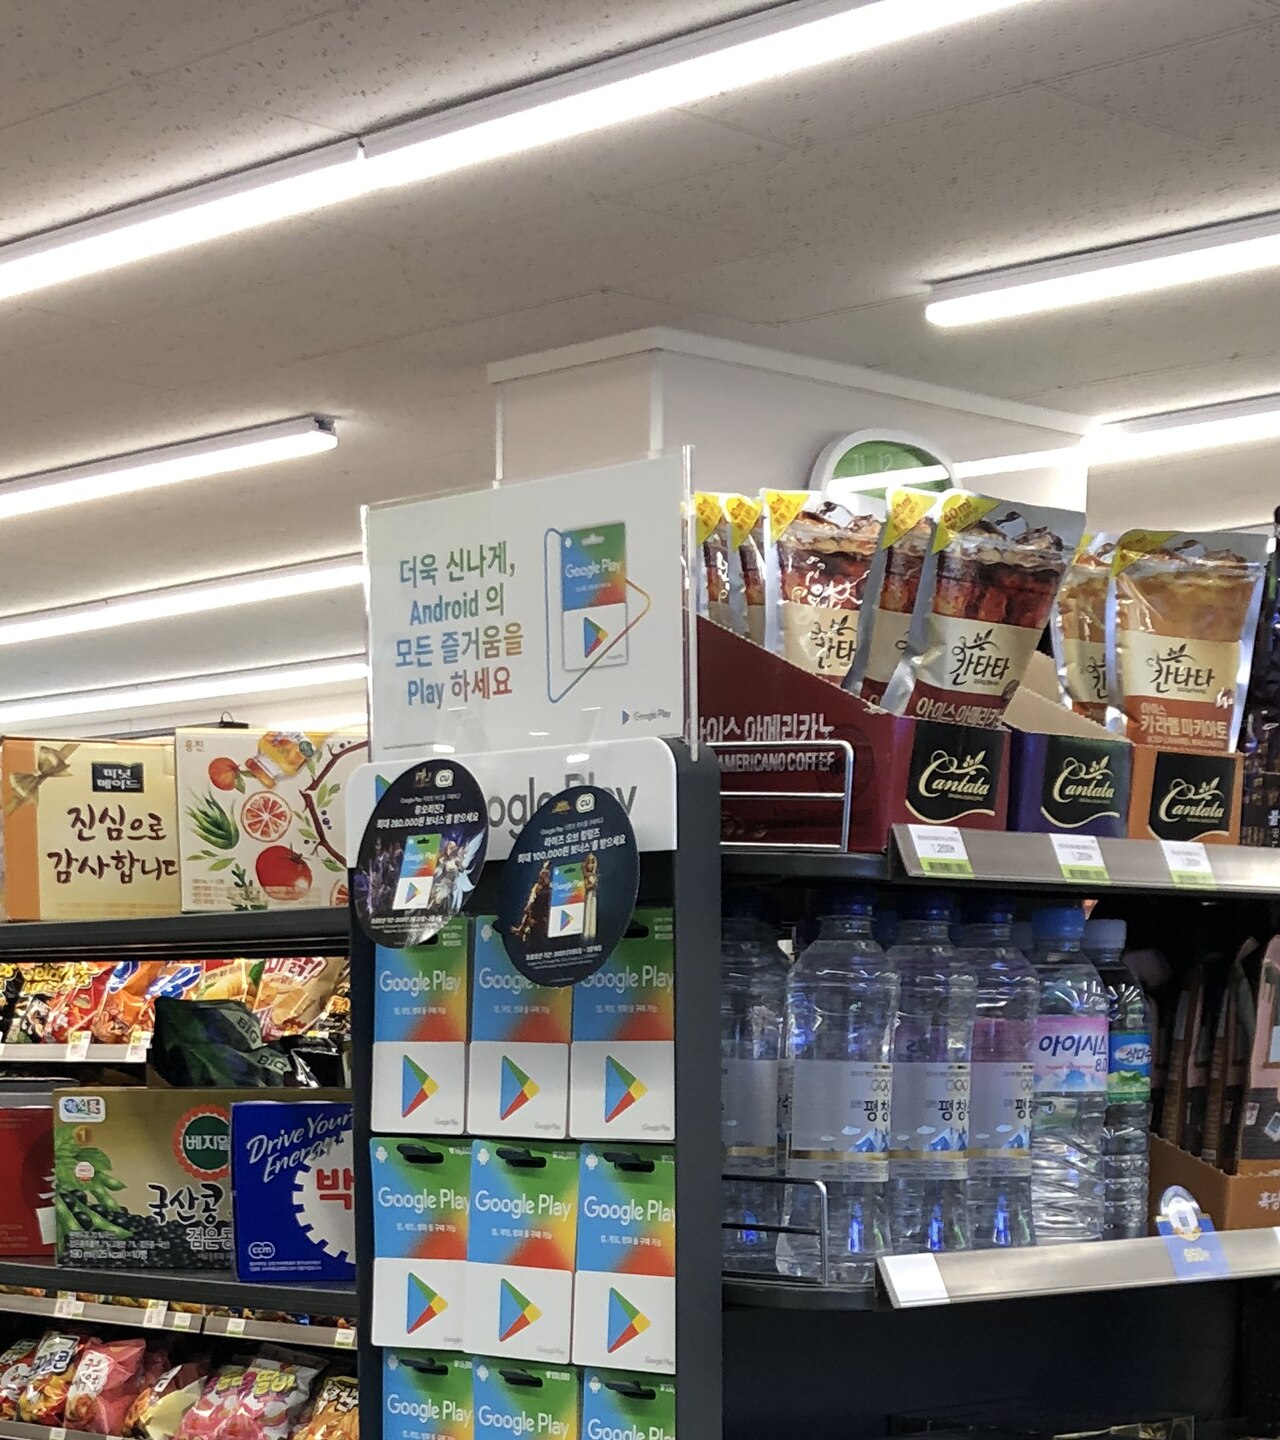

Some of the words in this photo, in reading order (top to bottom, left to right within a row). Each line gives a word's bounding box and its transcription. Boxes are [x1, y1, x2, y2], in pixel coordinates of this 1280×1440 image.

[400, 554, 438, 588] 더욱
[446, 541, 515, 582] 신나게,
[410, 589, 479, 626] Android
[486, 582, 504, 616] 의
[395, 635, 434, 668] 모든
[441, 622, 523, 664] 즐거움을
[950, 640, 1011, 688] 칸타타
[1150, 655, 1216, 695] 칸타타
[408, 678, 444, 710] Play
[450, 666, 513, 703] 하세요
[744, 713, 834, 741] 아메리카노
[97, 778, 141, 790] 메이드
[920, 755, 990, 799] Cantata
[1053, 764, 1115, 804] Cantata
[1158, 782, 1225, 822] Cantata
[67, 804, 167, 842] 진심으로
[379, 970, 430, 997] Google
[432, 970, 460, 997] Play
[642, 965, 674, 993] Play
[237, 1016, 259, 1045] BIG
[257, 1054, 288, 1072] BIG
[246, 1124, 304, 1165] Drive
[306, 1108, 354, 1140] Your
[147, 1182, 225, 1226] 국산콩
[378, 1187, 437, 1214] Google
[440, 1188, 470, 1215] Play
[474, 1190, 535, 1219] Google
[538, 1193, 571, 1221] Play
[583, 1196, 644, 1226] Google
[253, 1244, 272, 1255] ccm
[387, 1394, 440, 1423] Google
[442, 1400, 473, 1428] Play
[478, 1405, 535, 1436] Google
[537, 1413, 570, 1440] Play
